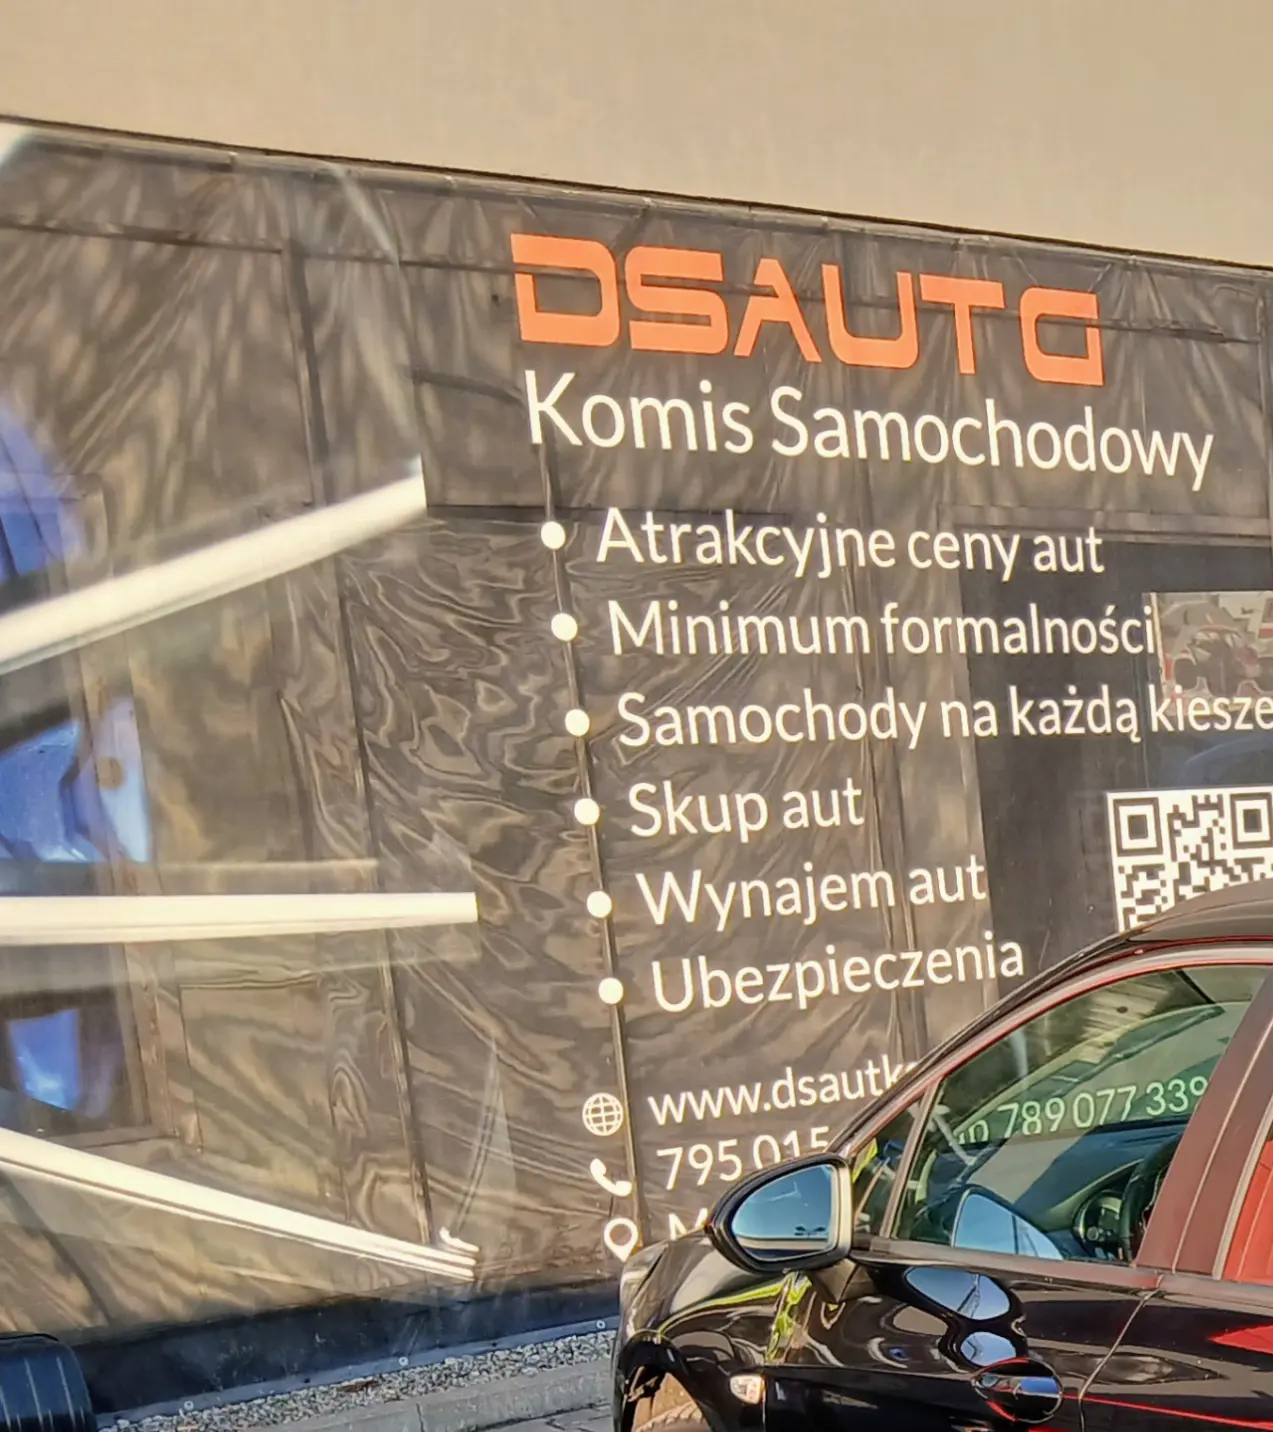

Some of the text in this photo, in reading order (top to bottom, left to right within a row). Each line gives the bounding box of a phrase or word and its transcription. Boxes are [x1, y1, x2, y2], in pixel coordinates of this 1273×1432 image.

[524, 369, 1214, 490] Komis Samochodowy
[596, 507, 1105, 581] Atrakcyjne ceny aut
[608, 599, 1154, 655] Minimum formalności
[617, 687, 927, 750] Samochody
[940, 700, 998, 738] na
[1009, 684, 1140, 743] każdą
[628, 777, 865, 843] Skup aut
[636, 854, 987, 932] Wynajem aut
[651, 930, 1024, 1012] Ubezpieczenia
[647, 1054, 917, 1126] www.dsautk
[998, 1097, 1065, 1138] 789
[1072, 1086, 1137, 1129] 077
[656, 1138, 742, 1190] 795
